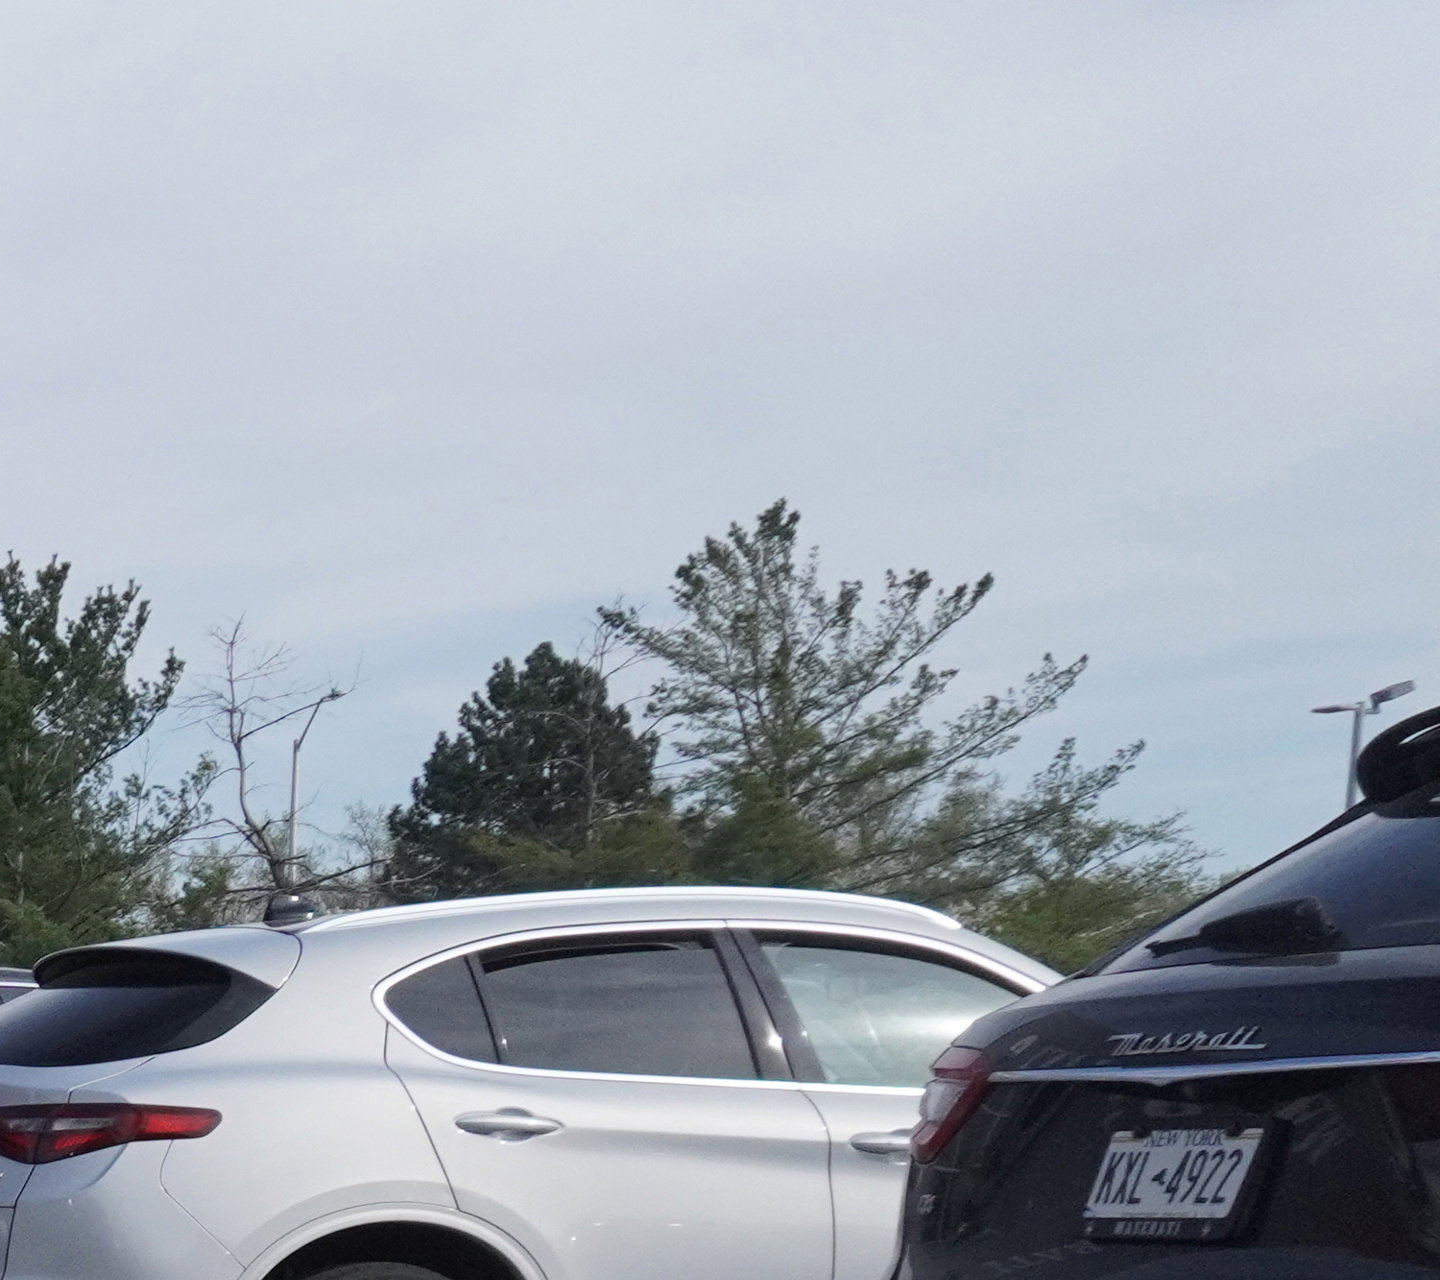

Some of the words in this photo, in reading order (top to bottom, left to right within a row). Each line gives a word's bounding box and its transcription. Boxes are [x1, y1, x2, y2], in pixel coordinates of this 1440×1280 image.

[1108, 1025, 1268, 1056] Maserati
[1144, 1131, 1179, 1147] NEW
[1184, 1129, 1224, 1146] YORK
[1093, 1151, 1150, 1204] KXL
[1164, 1149, 1244, 1203] 4922
